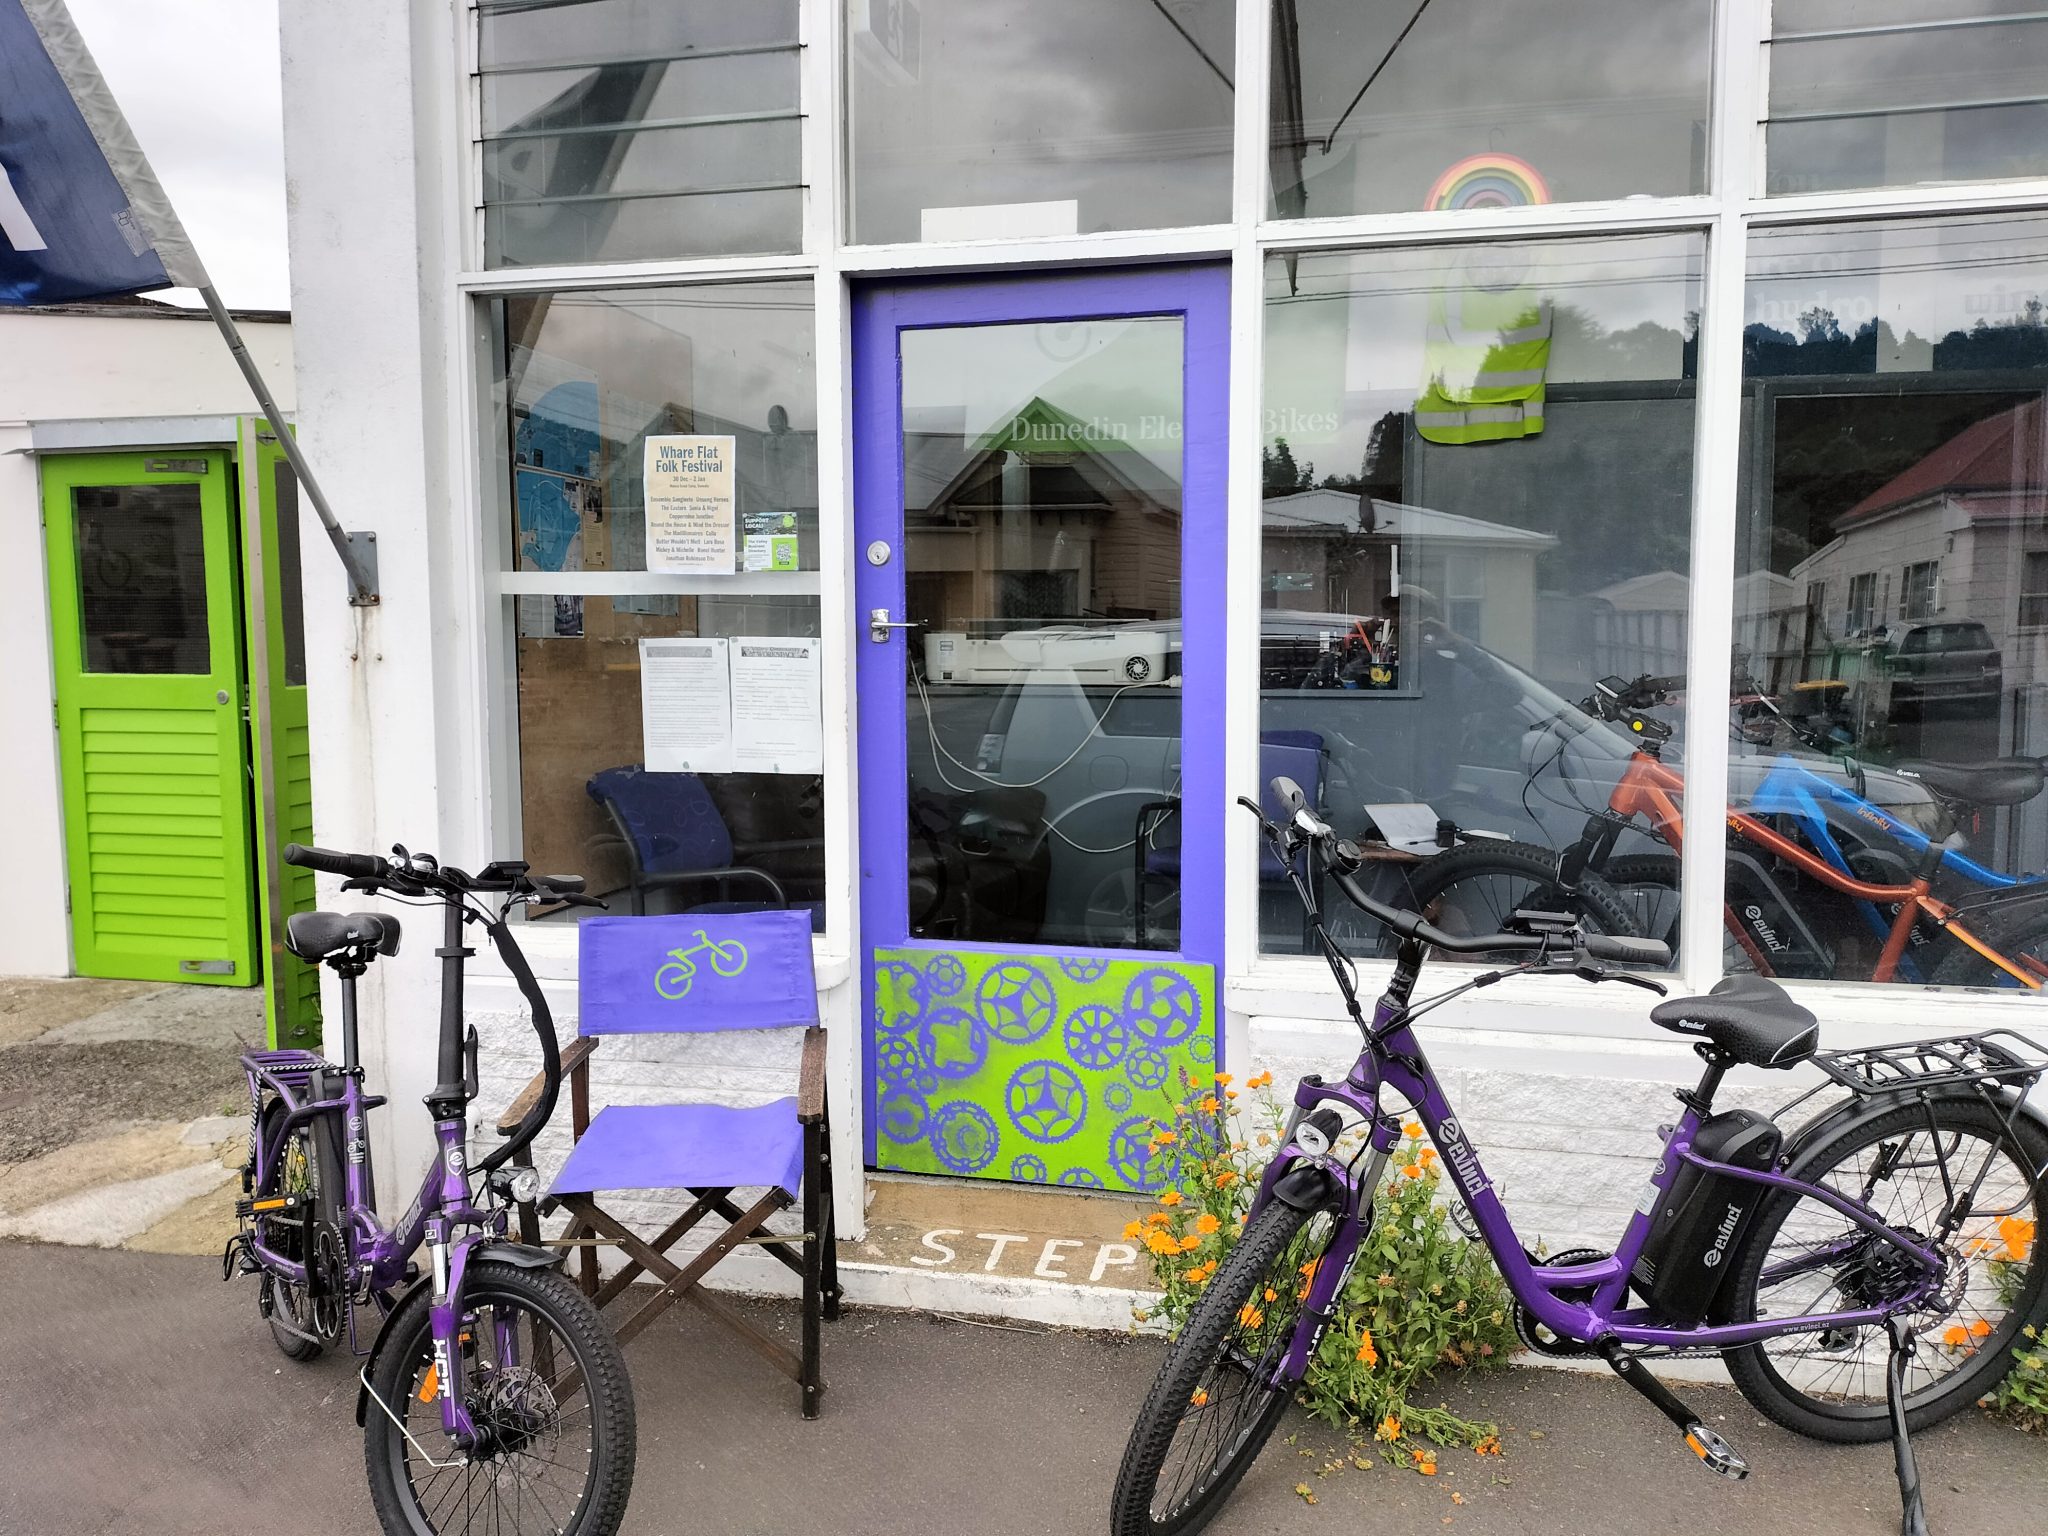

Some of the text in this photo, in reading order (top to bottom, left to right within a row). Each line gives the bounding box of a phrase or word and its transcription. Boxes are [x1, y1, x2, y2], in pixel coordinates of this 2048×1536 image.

[1011, 408, 1339, 441] Dunedin Ele Bikes
[660, 446, 718, 459] Whare Flat
[656, 460, 723, 473] Folk Festival
[910, 1229, 1138, 1281] STEP
